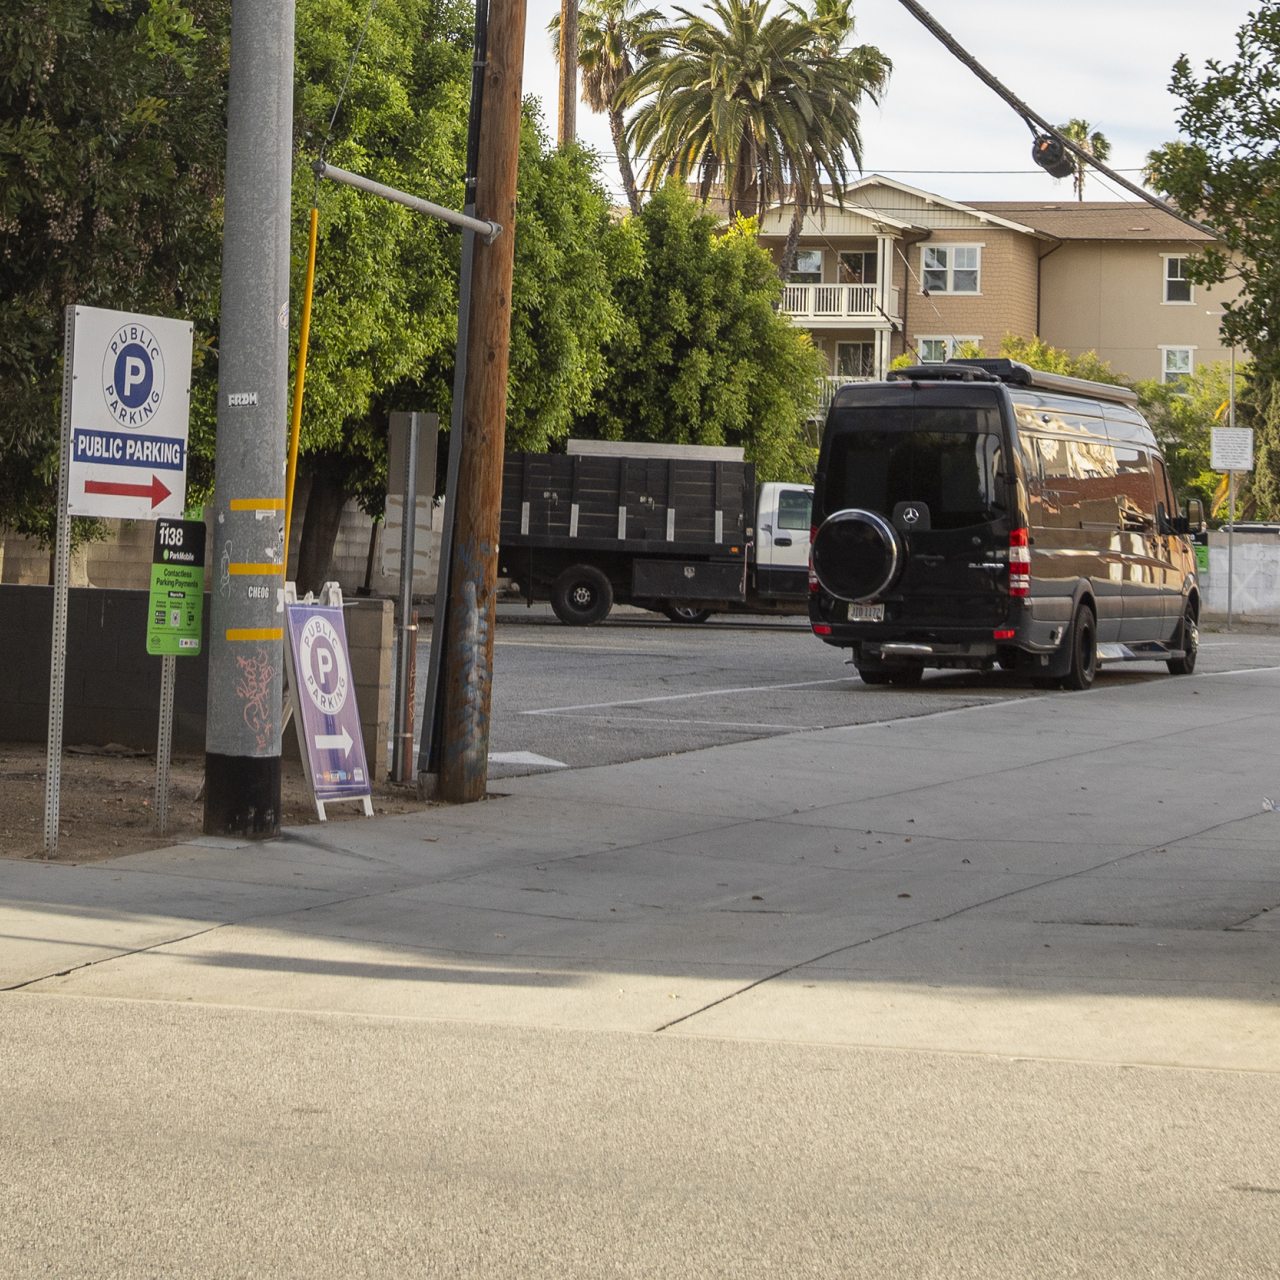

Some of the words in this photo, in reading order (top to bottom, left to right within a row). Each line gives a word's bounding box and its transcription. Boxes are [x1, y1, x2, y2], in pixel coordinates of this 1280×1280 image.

[111, 327, 160, 361] PUBLIC
[123, 355, 146, 397] P
[105, 384, 160, 425] PARKING
[78, 435, 123, 459] PUBLIC
[126, 440, 180, 464] PARKING
[160, 527, 183, 546] 1138
[169, 551, 195, 561] ParkMobile
[304, 621, 339, 650] PUBLIC
[316, 647, 333, 685] P
[307, 675, 346, 711] PARKING
